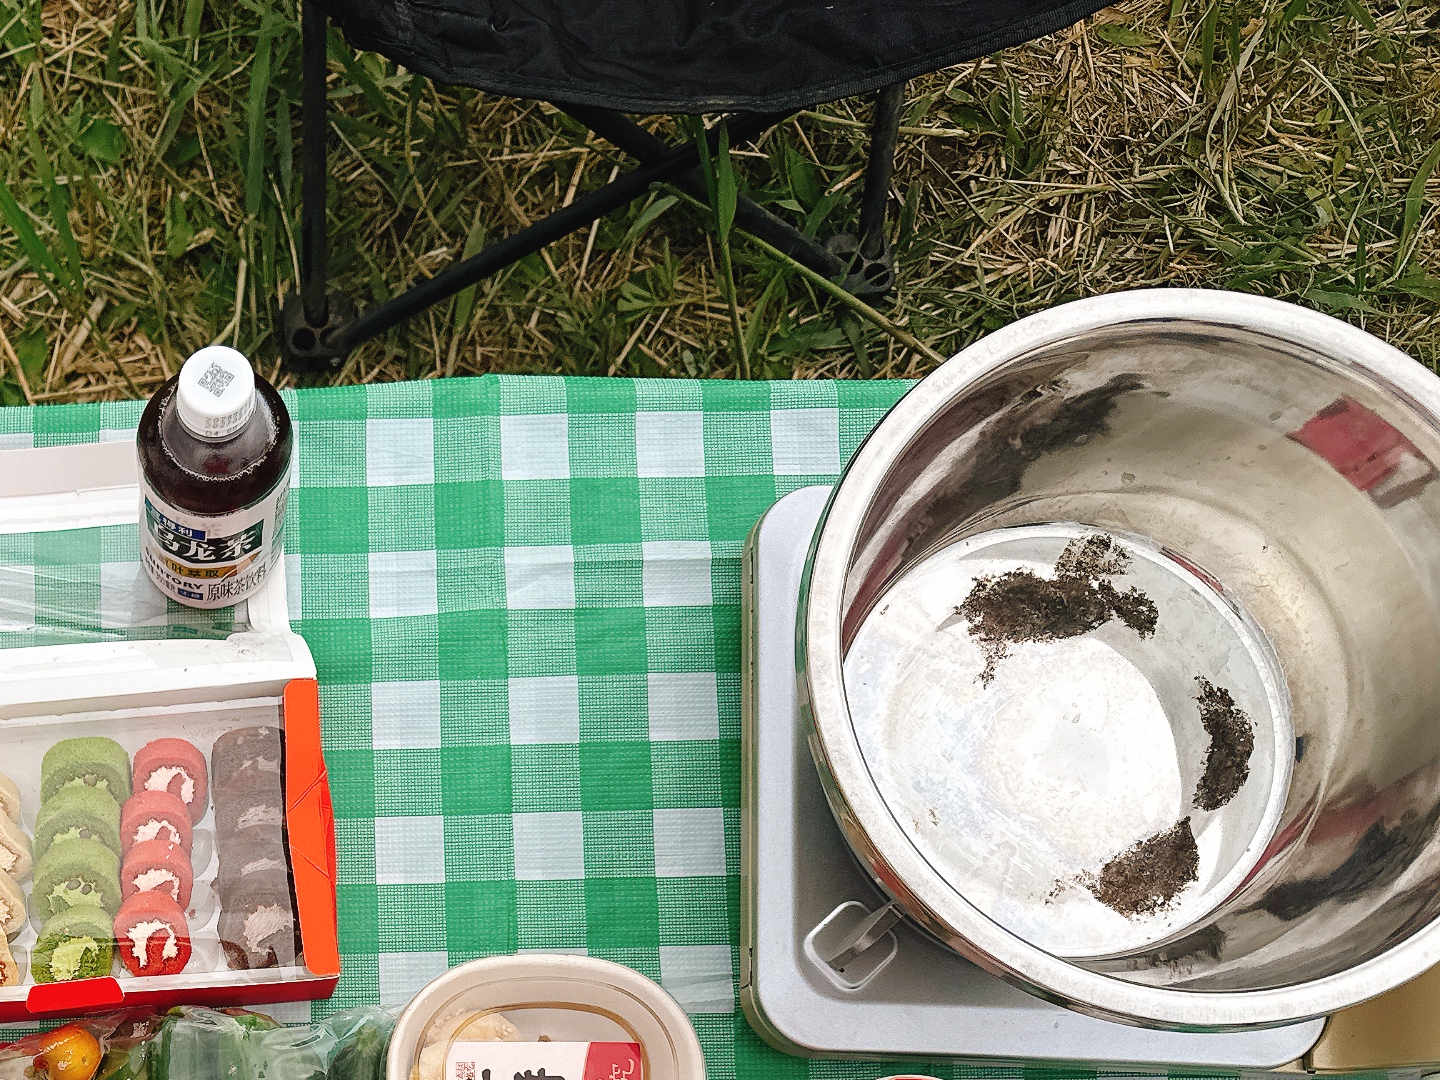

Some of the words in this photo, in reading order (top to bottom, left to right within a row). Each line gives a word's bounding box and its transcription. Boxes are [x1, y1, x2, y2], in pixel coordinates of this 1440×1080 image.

[152, 521, 257, 561] 乌龙茶
[206, 562, 267, 601] 原味茶饮料
